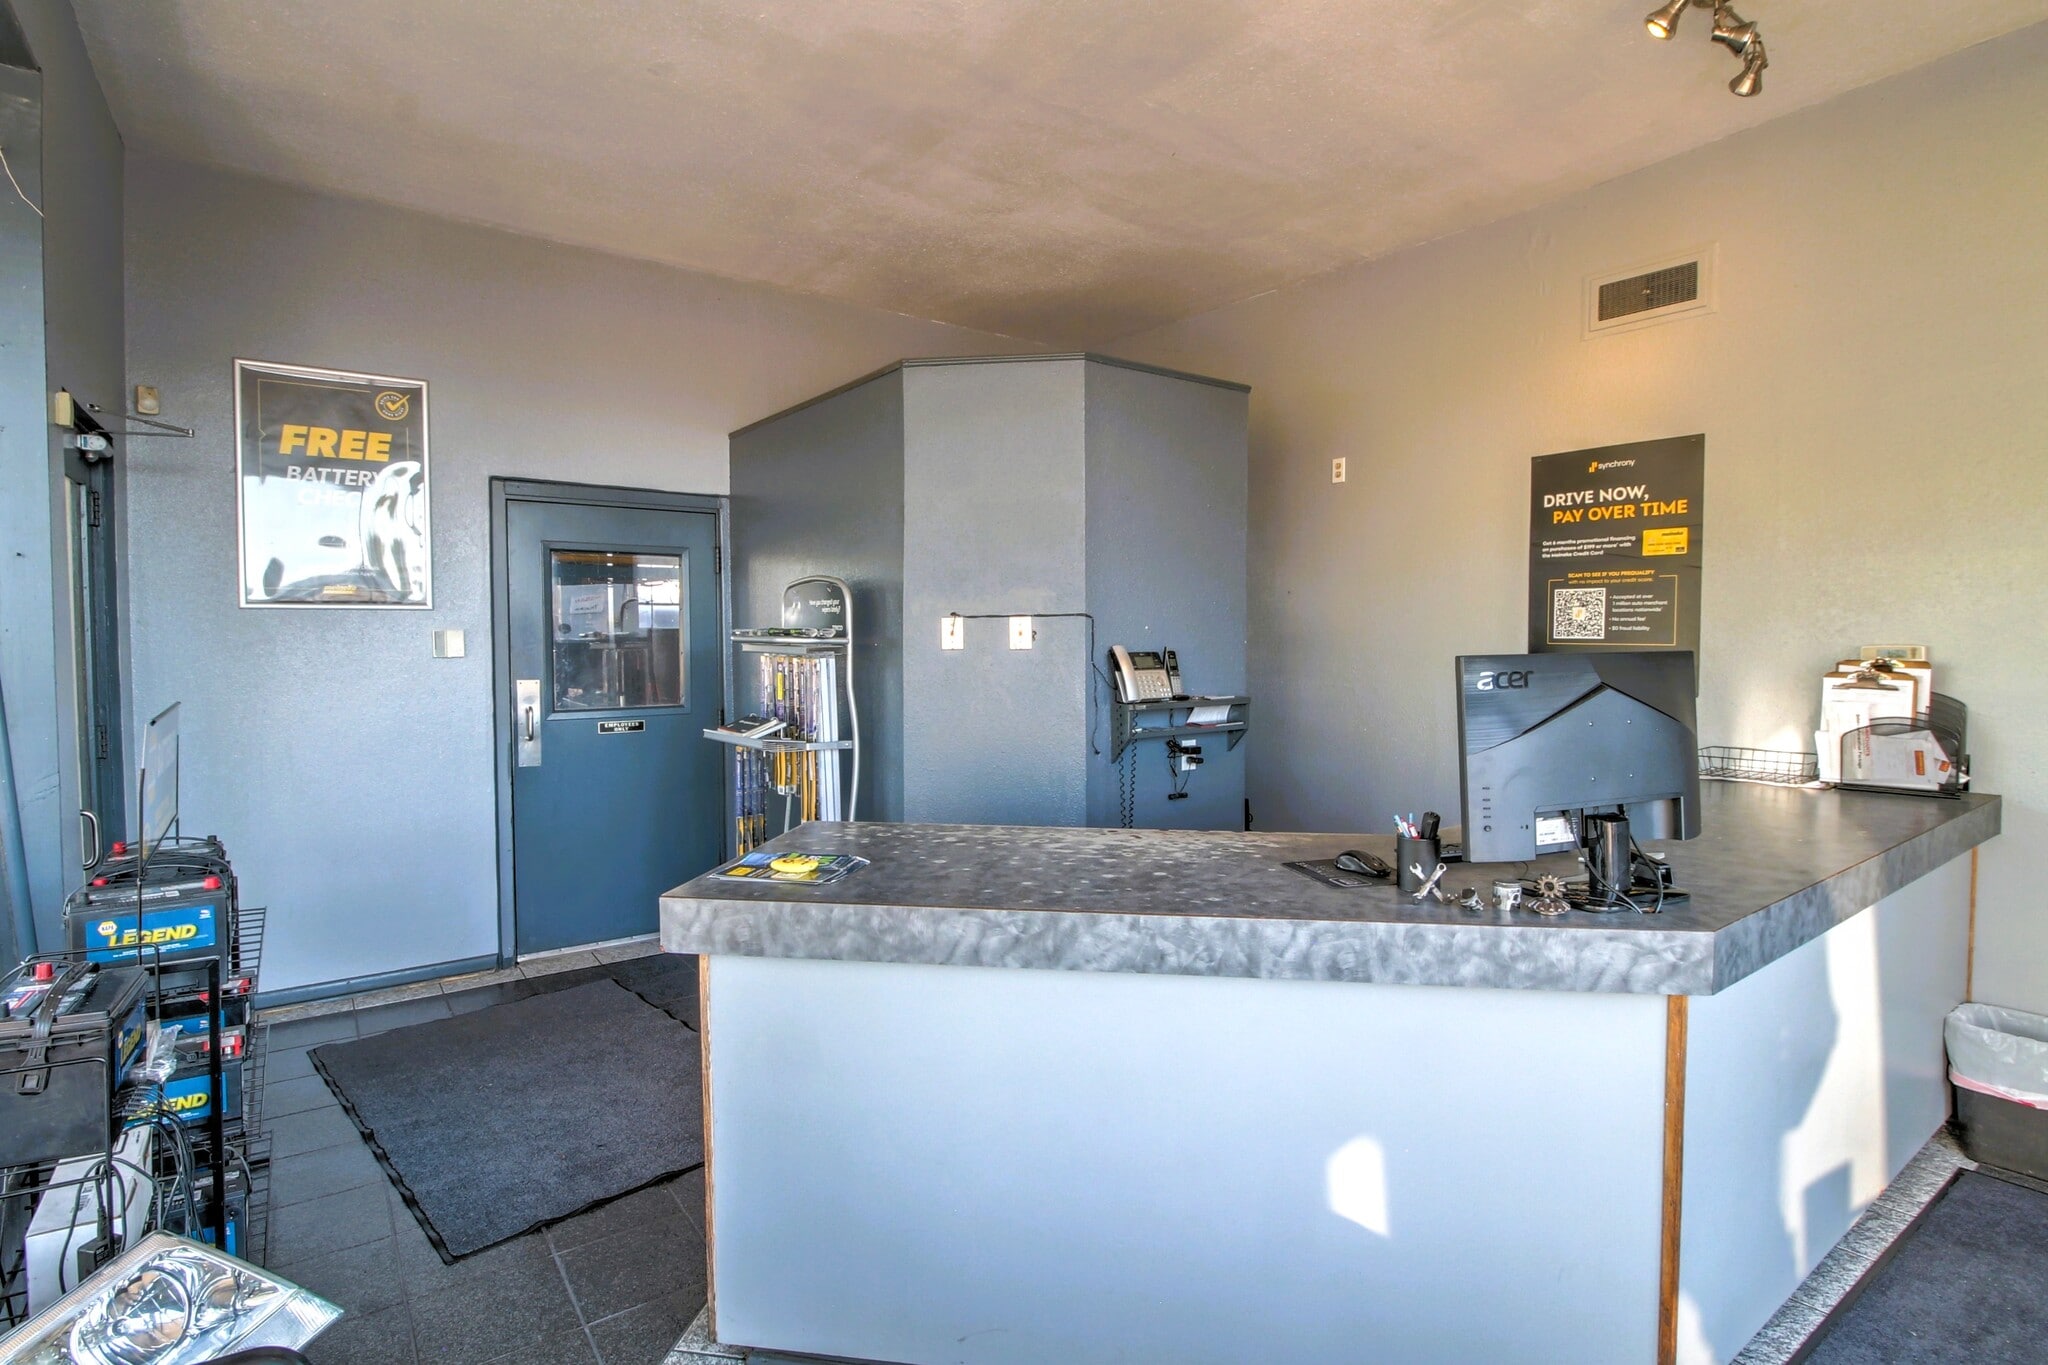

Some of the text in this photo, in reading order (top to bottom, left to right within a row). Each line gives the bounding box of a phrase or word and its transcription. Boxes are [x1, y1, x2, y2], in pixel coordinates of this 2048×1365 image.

[278, 424, 393, 462] FREE
[1598, 459, 1636, 471] synchrony
[1543, 484, 1650, 508] DRIVE NOW,
[1553, 499, 1689, 525] PAY OVER TIME
[1476, 670, 1534, 691] acer
[109, 924, 198, 947] LEGEND
